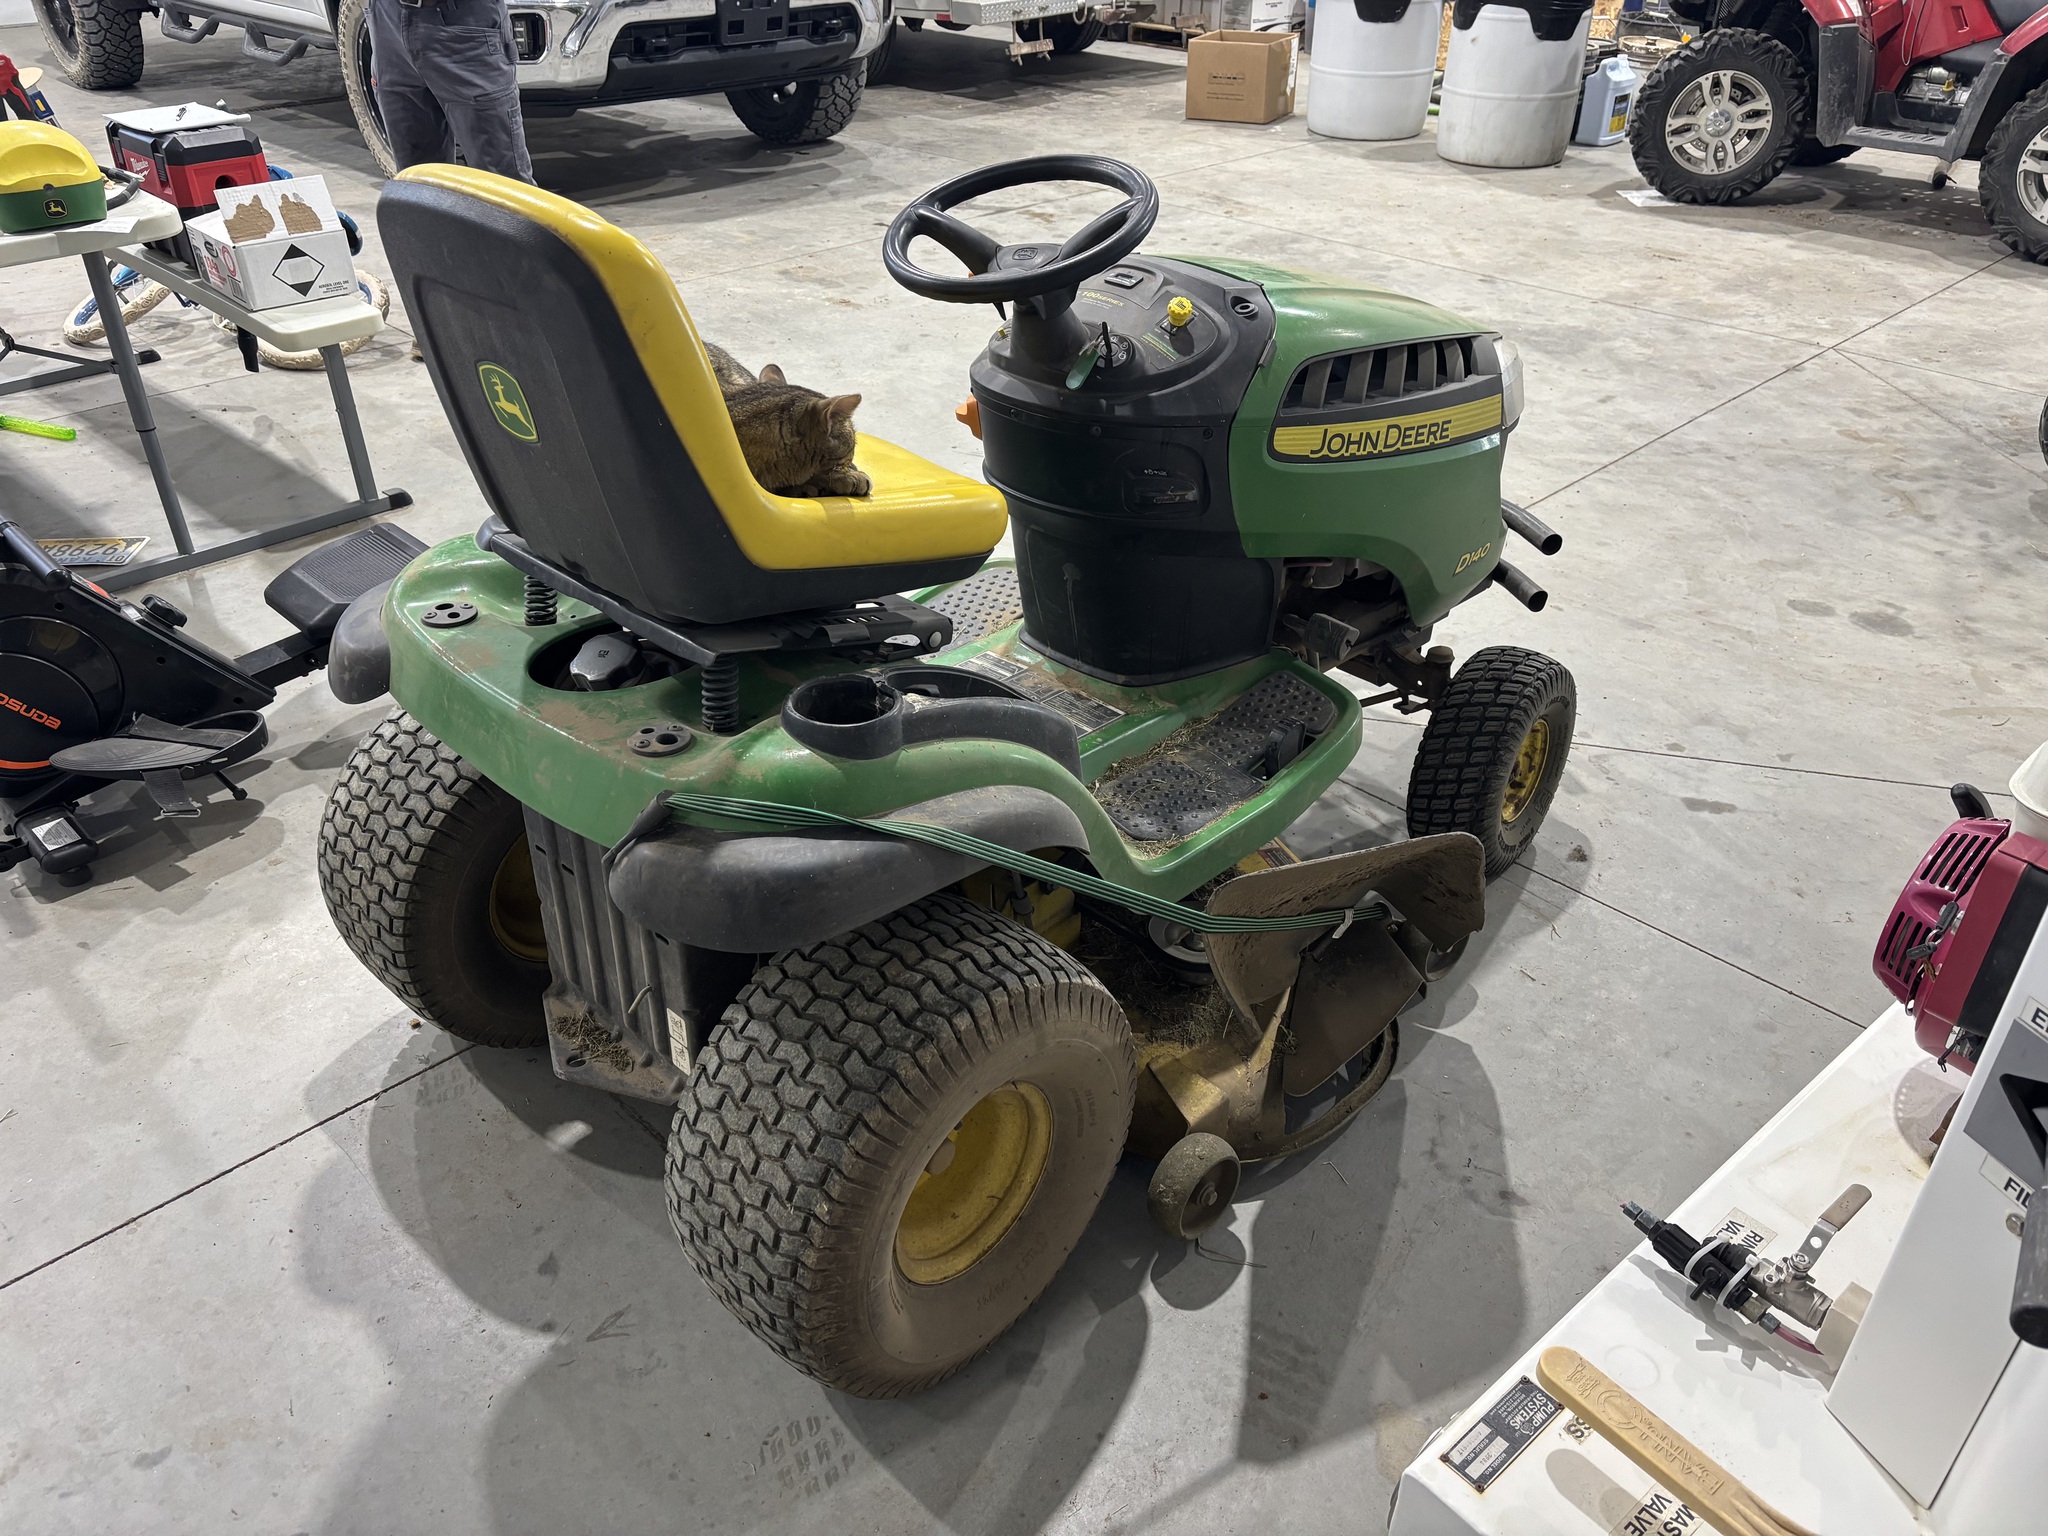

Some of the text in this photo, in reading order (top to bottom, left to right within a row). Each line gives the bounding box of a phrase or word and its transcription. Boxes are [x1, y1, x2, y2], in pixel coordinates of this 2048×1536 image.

[1310, 419, 1452, 456] JOHN DEERE
[1453, 542, 1491, 577] D140
[1509, 1393, 1547, 1430] SYSTEMS
[1529, 1402, 1555, 1427] PUMP
